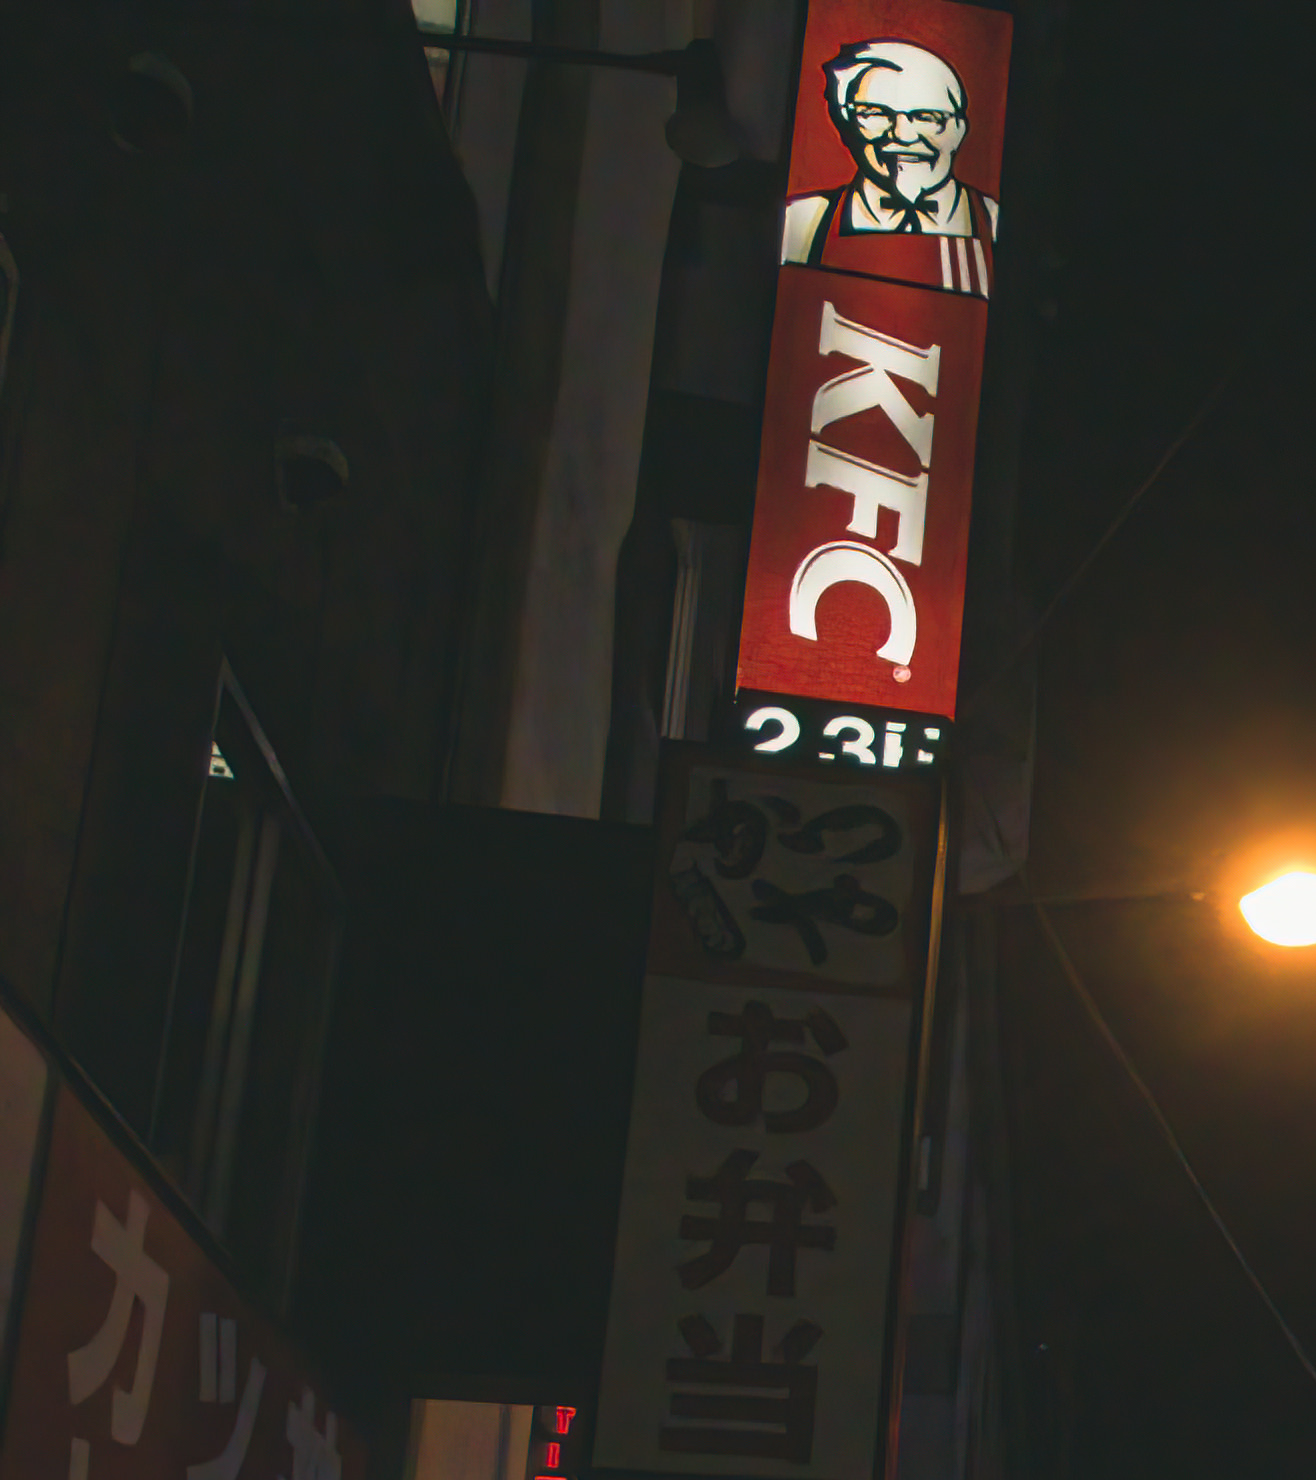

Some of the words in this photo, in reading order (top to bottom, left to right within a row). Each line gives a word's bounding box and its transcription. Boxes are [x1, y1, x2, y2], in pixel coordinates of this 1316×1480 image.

[789, 301, 941, 667] KFC
[659, 1000, 850, 1463] お弁当
